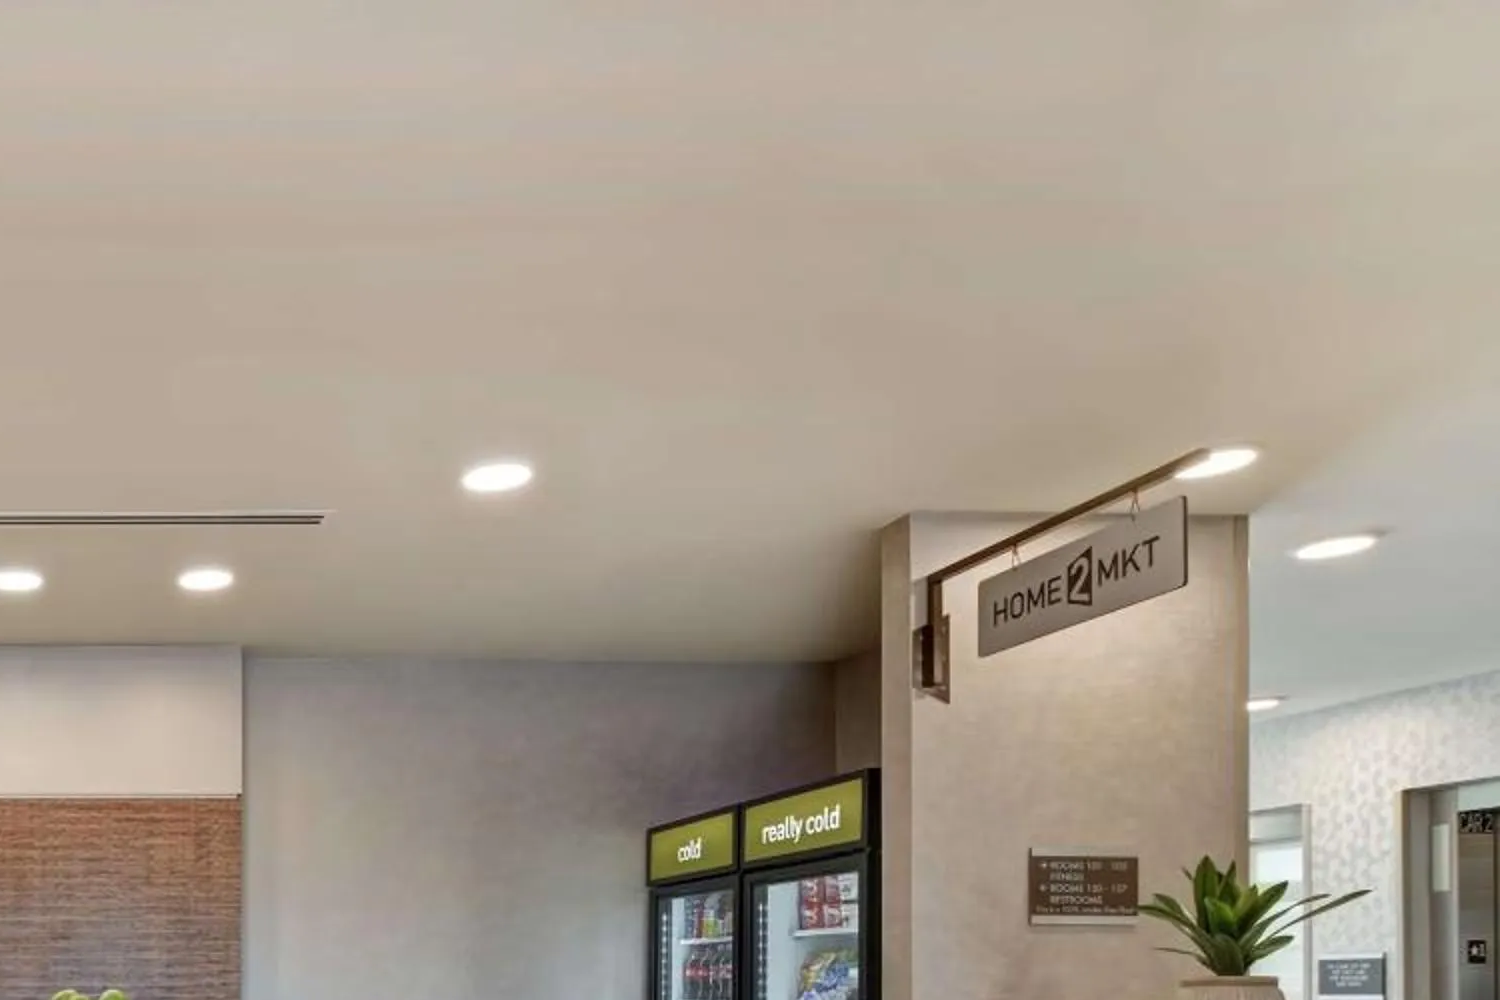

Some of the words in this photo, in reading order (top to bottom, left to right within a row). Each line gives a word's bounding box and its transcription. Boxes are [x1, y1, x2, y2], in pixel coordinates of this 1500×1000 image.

[1097, 535, 1161, 587] MKT
[761, 815, 803, 845] really
[805, 803, 842, 835] cold
[677, 837, 703, 863] cold
